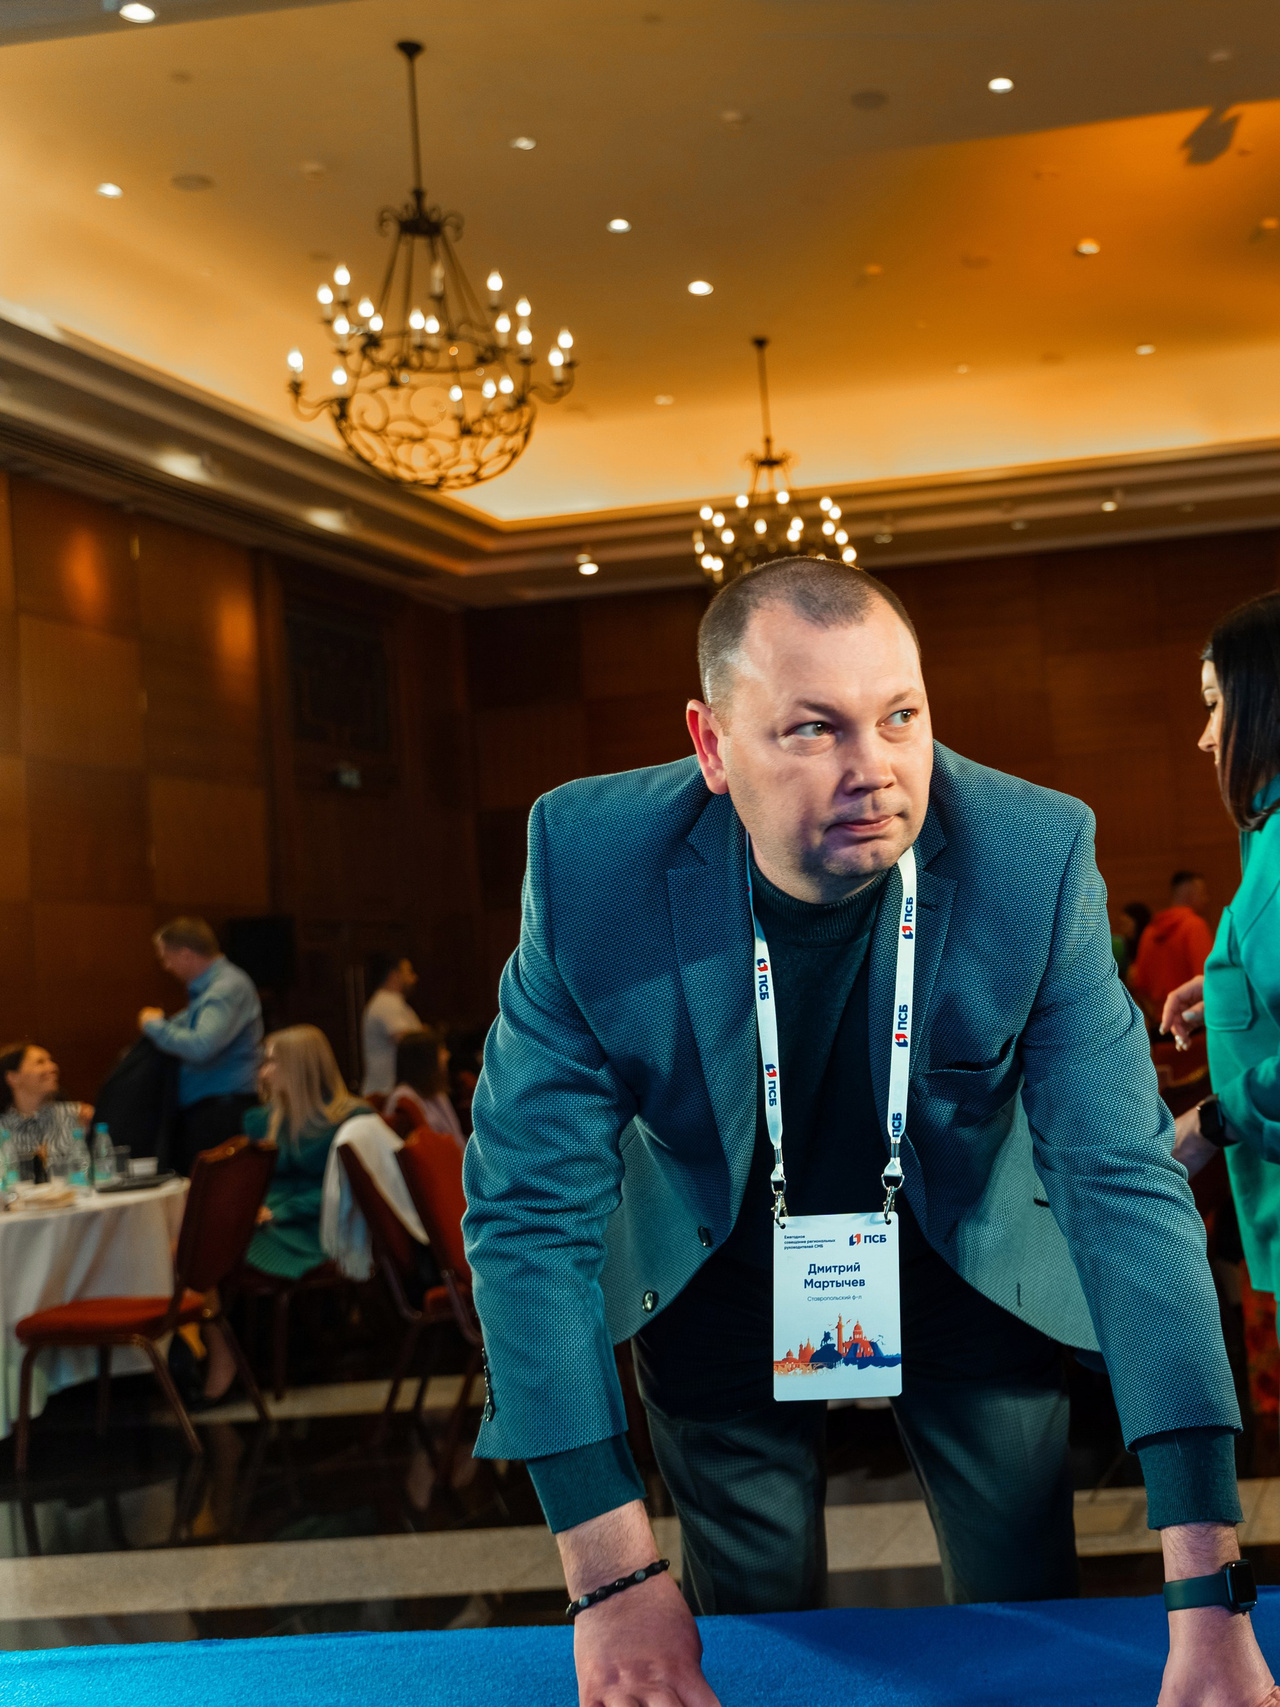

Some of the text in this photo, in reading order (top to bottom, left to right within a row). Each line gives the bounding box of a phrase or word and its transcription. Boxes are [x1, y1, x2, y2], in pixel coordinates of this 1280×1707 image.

[904, 896, 914, 923] ПСБ
[758, 974, 770, 1001] ПСБ
[898, 1004, 909, 1031] ПСБ
[768, 1080, 777, 1107] ПСБ
[892, 1112, 902, 1138] ПСБ
[864, 1234, 887, 1244] ПСБ
[808, 1262, 860, 1275] Дмитрий
[804, 1279, 865, 1291] Мартычев
